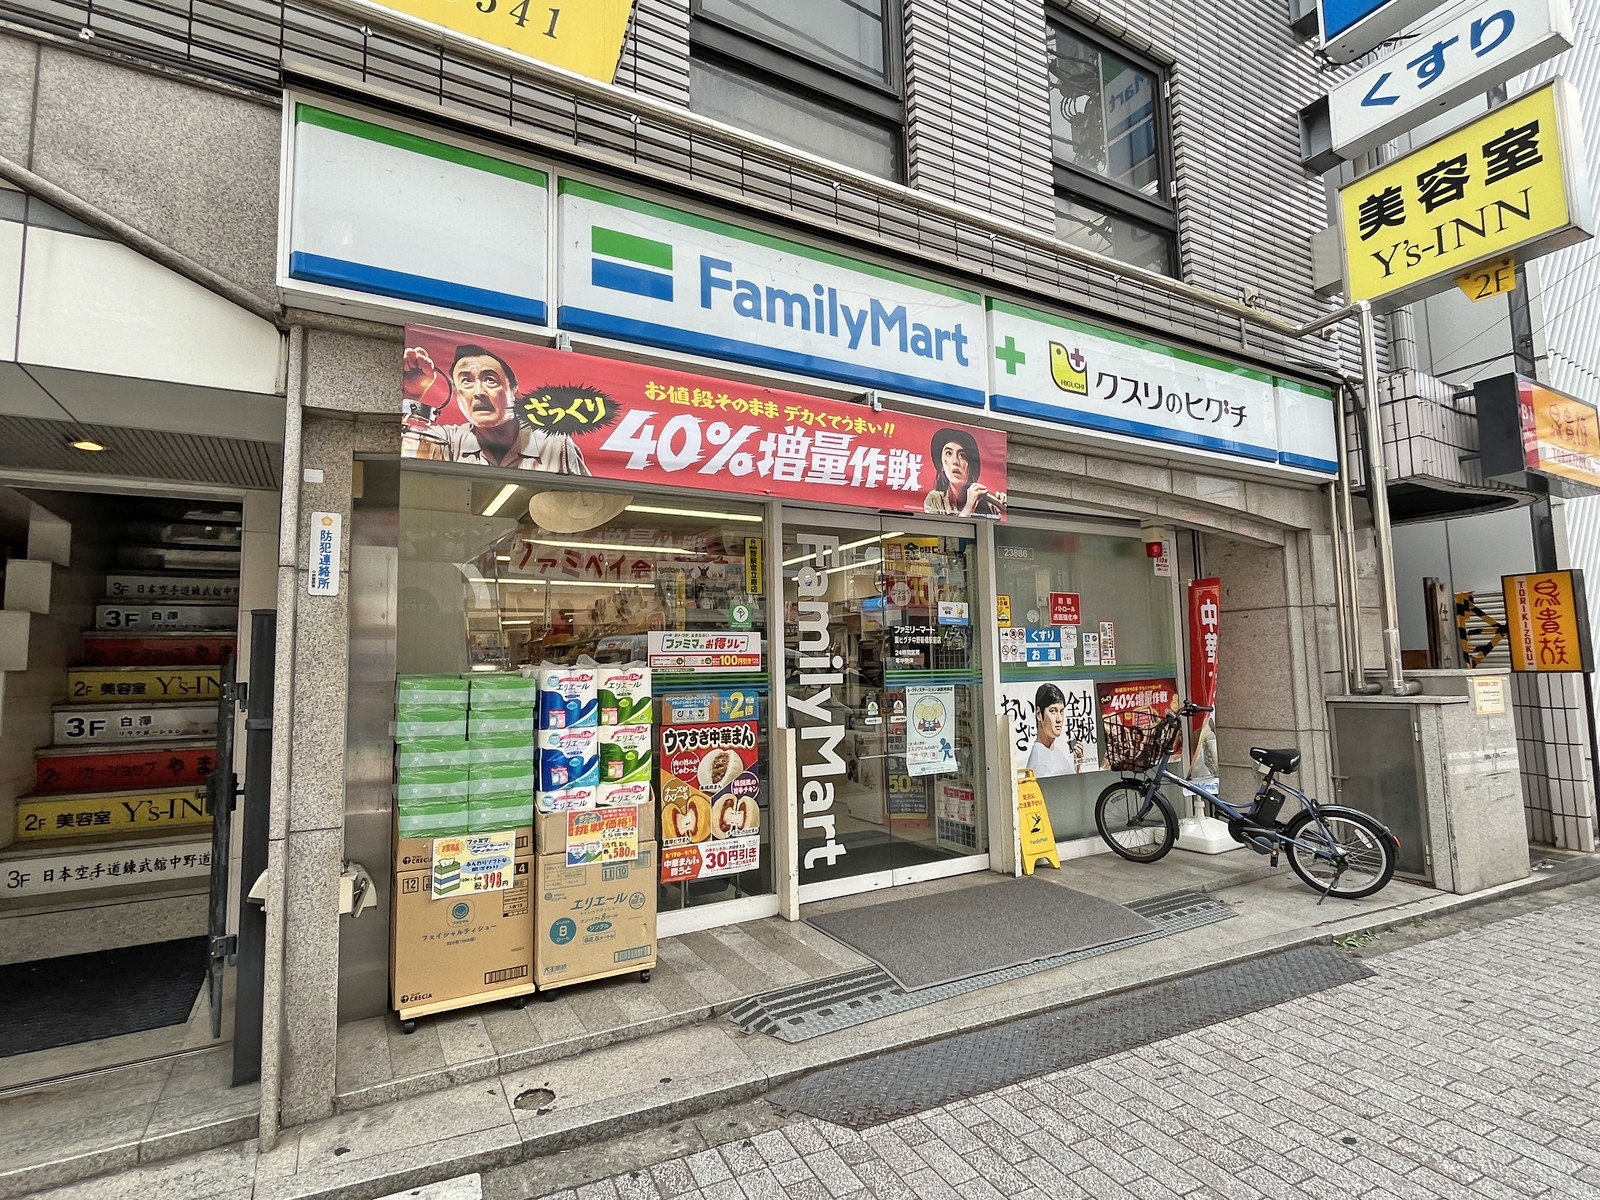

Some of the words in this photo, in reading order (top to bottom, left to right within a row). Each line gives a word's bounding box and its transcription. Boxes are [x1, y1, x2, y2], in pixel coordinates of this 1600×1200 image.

[1360, 9, 1515, 107] くすり
[1358, 119, 1543, 241] 美容室
[1474, 266, 1511, 300] 2F
[699, 254, 969, 368] FamilyMart
[1060, 378, 1085, 391] HIGUCHI
[644, 380, 780, 419] お値段そのまま
[1095, 371, 1248, 428] クスリのヒグチ
[523, 395, 606, 427] ざっくり
[600, 408, 924, 493] 40%増量作戦
[317, 529, 333, 590] 防犯連絡所
[1003, 548, 1028, 558] 23886
[112, 582, 129, 596] 3F
[105, 610, 140, 628] 3F
[1533, 578, 1569, 665] 鳥貴族
[894, 626, 936, 634] ファミリーマート
[1031, 630, 1055, 641] くすり
[1031, 649, 1057, 661] お酒
[74, 680, 92, 697] 2F
[101, 683, 147, 696] 美容室
[555, 682, 591, 691] エリエール
[607, 681, 642, 690] エリエール
[787, 533, 847, 870] FamilyMart
[1065, 690, 1092, 718] 全力
[1110, 690, 1169, 711] 40%増量作戦
[66, 717, 106, 737] 3F
[556, 739, 592, 749] エリエール
[615, 734, 647, 743] エリエール
[664, 724, 754, 753] ウマすぎ中華まん
[552, 799, 588, 811] エリエール
[24, 814, 47, 831] 2F
[55, 811, 112, 829] 美容室
[705, 847, 757, 870] 30円引き
[7, 870, 31, 889] 3F
[404, 879, 416, 890] 12
[570, 892, 629, 911] エリエール
[422, 924, 497, 941] フェイシャルティシュー
[559, 925, 568, 937] 8
[589, 922, 610, 932] シングル
[409, 992, 433, 1002] CRECIA
